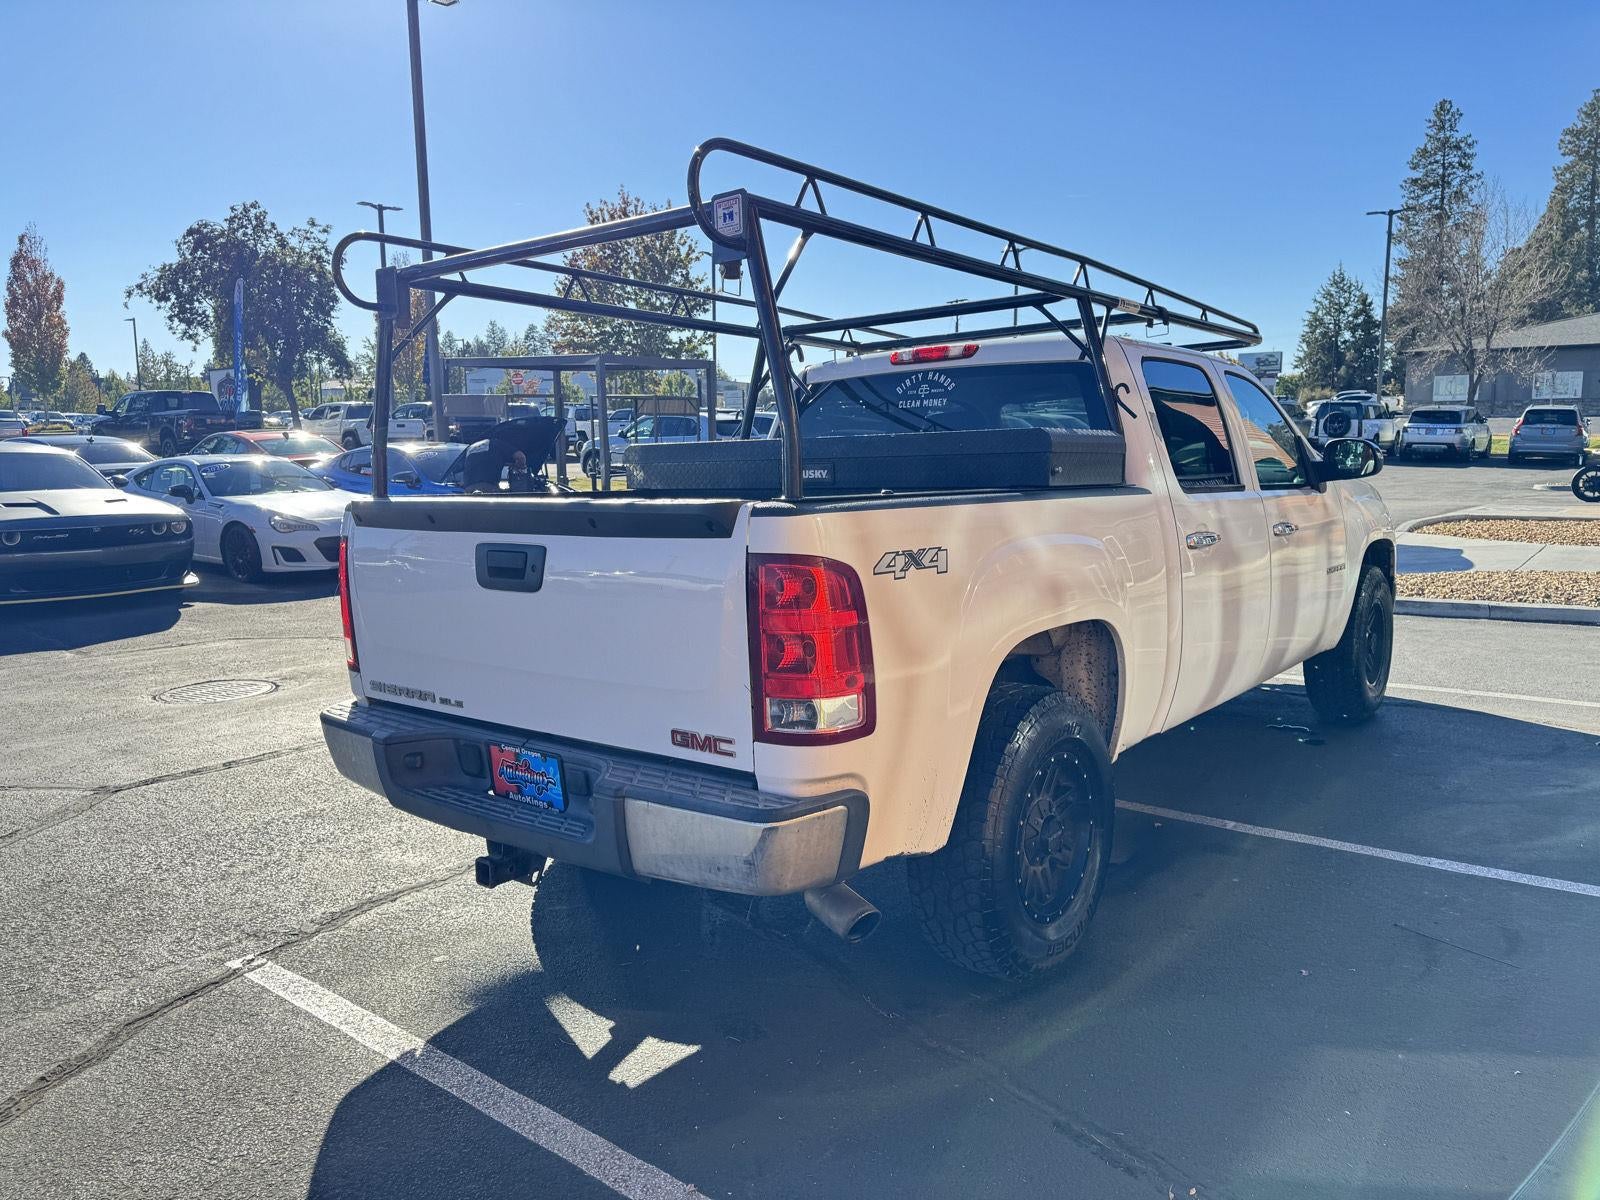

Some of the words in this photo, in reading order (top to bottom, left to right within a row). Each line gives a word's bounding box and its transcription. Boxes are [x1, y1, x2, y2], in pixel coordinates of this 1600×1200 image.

[896, 372, 923, 394] DIRTY
[927, 371, 956, 391] HANDS
[898, 399, 920, 409] CLEAN
[922, 398, 948, 408] MONEY
[802, 469, 829, 479] USKY
[671, 728, 737, 758] GMC
[501, 744, 520, 753] Central
[521, 748, 542, 757] Oregon
